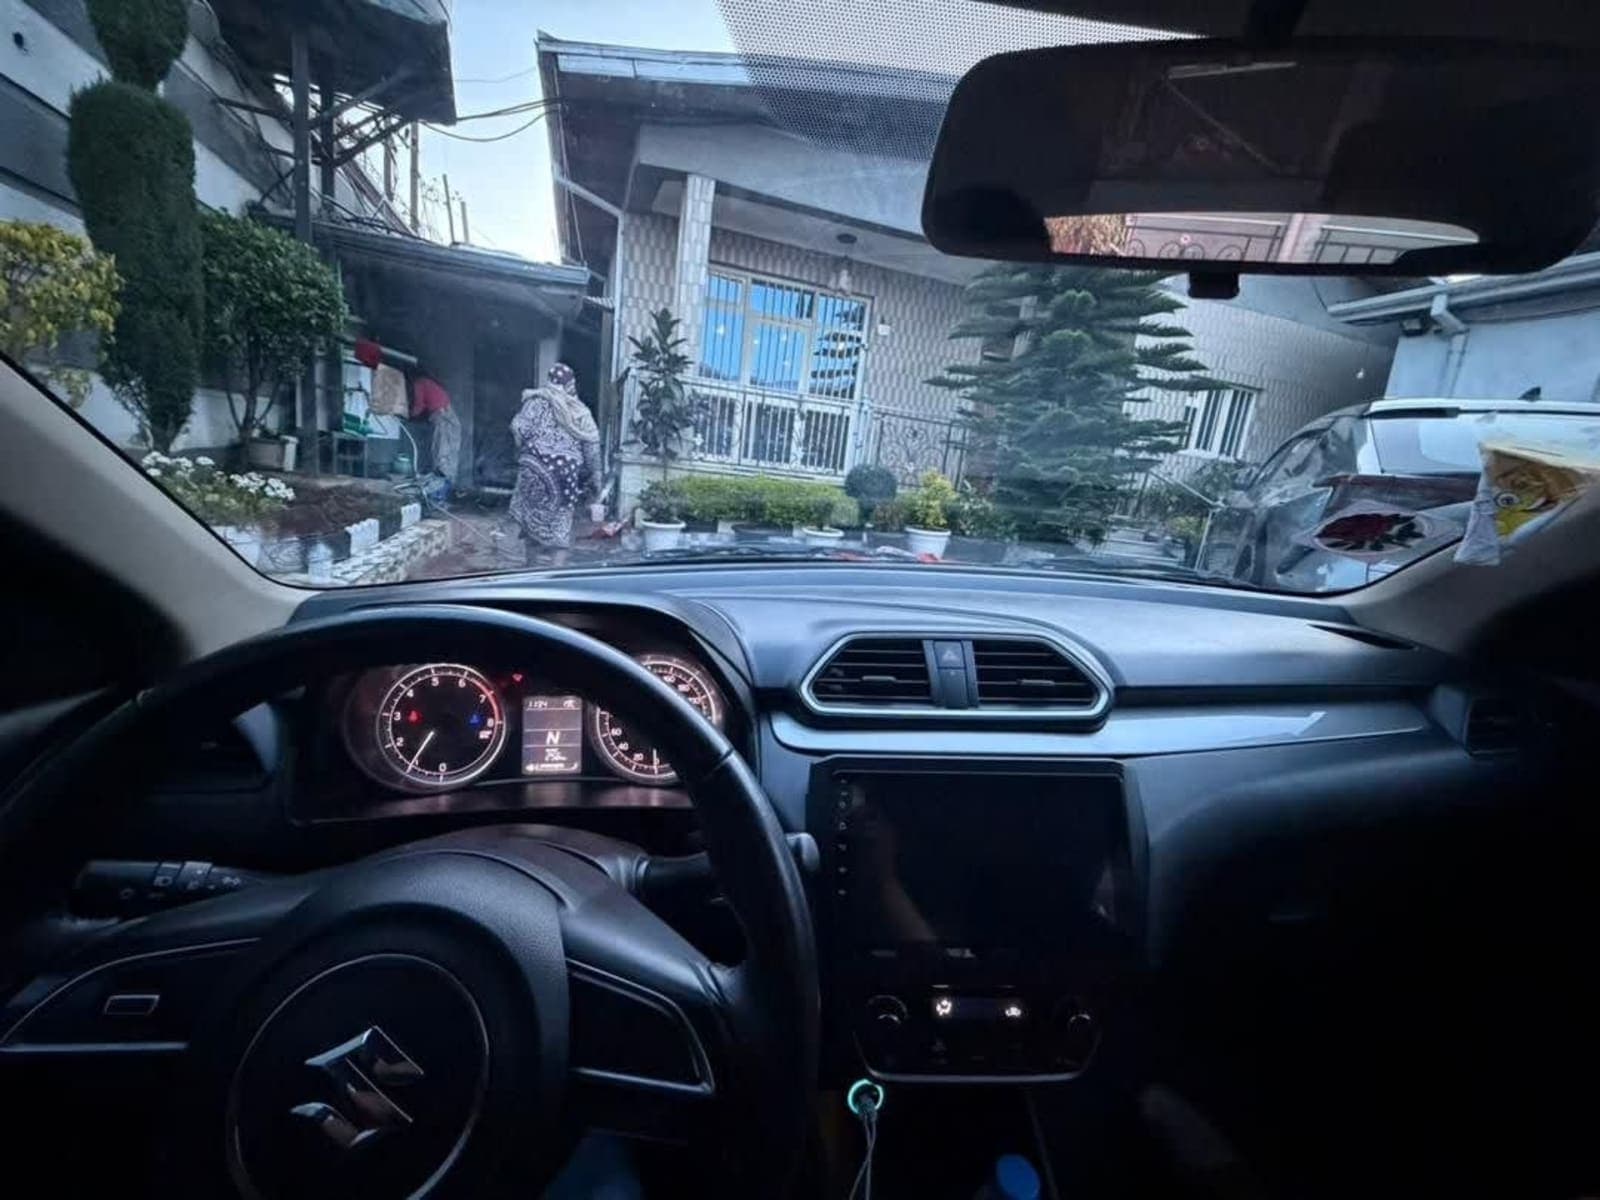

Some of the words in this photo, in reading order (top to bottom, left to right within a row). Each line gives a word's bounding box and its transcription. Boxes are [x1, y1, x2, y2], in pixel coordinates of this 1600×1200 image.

[431, 677, 439, 686] 5
[458, 678, 466, 688] 6
[407, 689, 414, 697] 4
[480, 694, 487, 703] 7
[393, 711, 401, 721] 3
[396, 737, 404, 747] 2
[546, 731, 561, 745] N
[439, 762, 448, 773] 0
